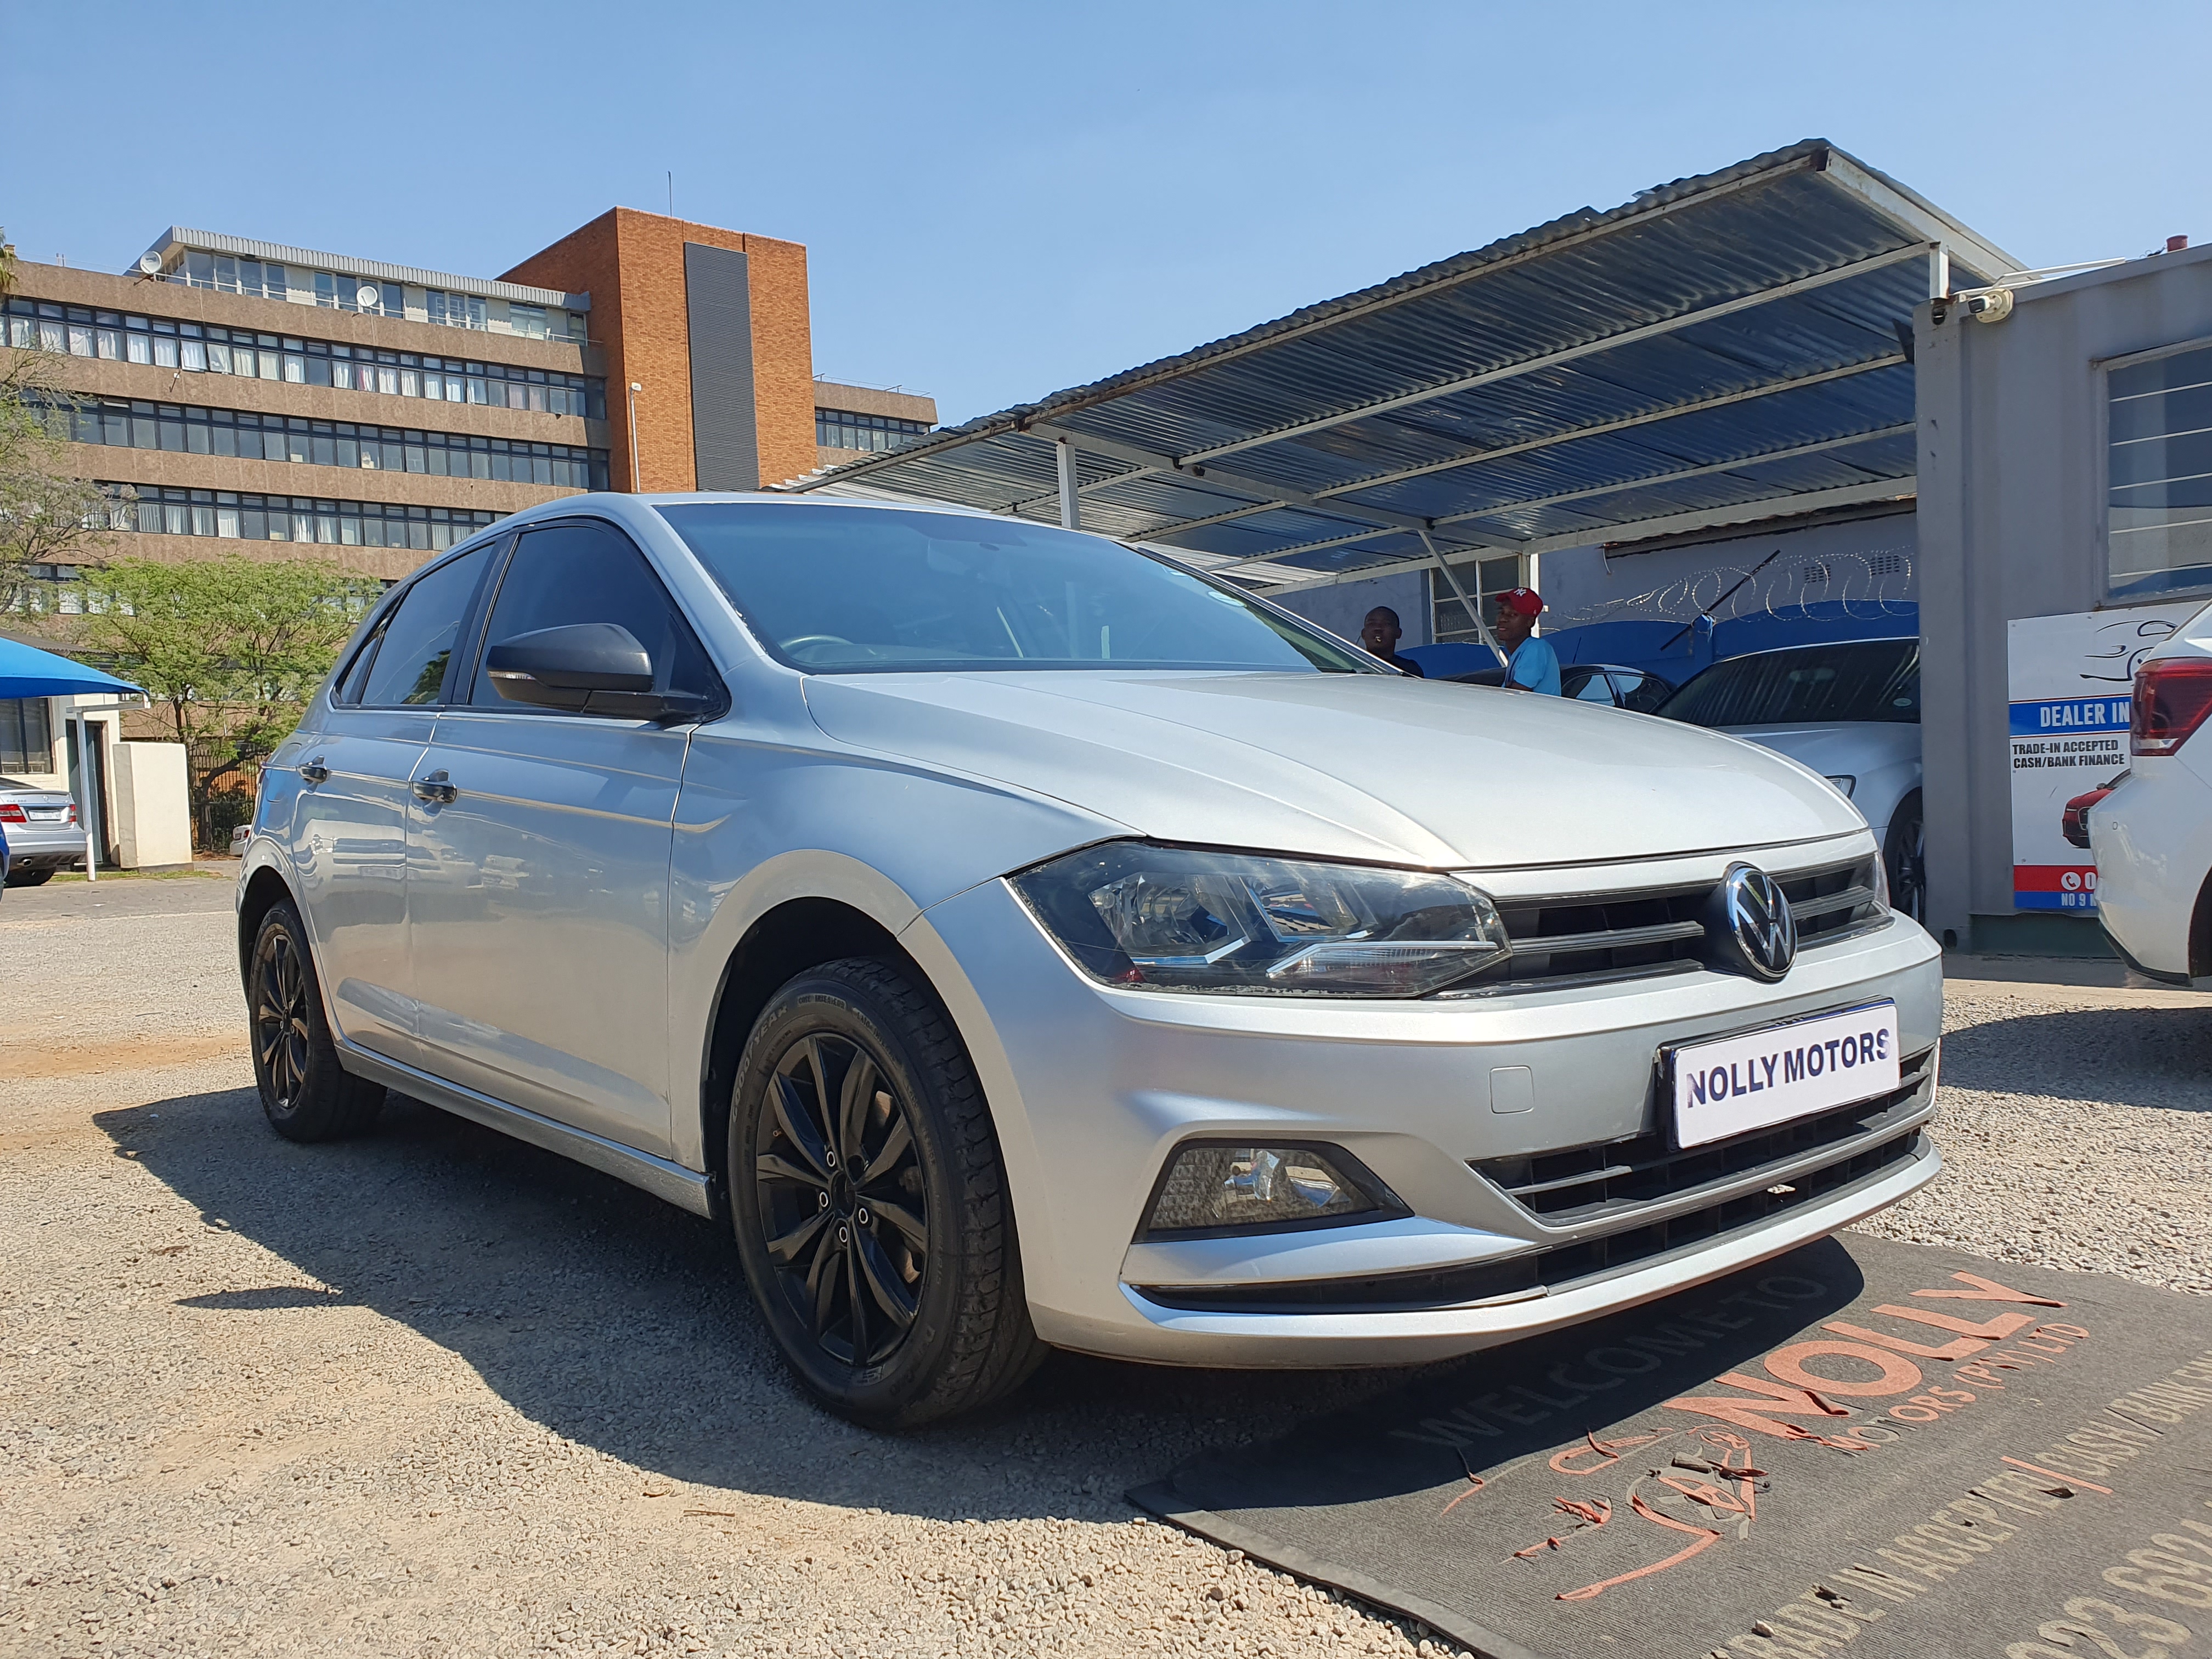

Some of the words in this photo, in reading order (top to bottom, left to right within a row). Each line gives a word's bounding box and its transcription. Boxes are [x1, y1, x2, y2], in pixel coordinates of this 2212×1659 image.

[2012, 742, 2061, 755] TRADE-IN
[2063, 740, 2118, 752] ACCEPTED
[2040, 703, 2106, 727] DEALER
[2112, 702, 2130, 724] IN
[2013, 755, 2076, 769] CASH/BANK
[2079, 754, 2125, 766] FINANCE
[2061, 893, 2075, 906] NO
[2079, 893, 2086, 906] 9
[732, 1005, 787, 1123] GOODYEAR
[1686, 1053, 1779, 1108] NOLLY
[1784, 1029, 1891, 1084] MOTORS
[1389, 1310, 1753, 1448] WELCOME
[1719, 1276, 1827, 1310] TO
[1661, 1269, 2068, 1440] NOLLY
[1822, 1386, 1976, 1457] MOTORS
[2018, 1323, 2090, 1353] LTD
[1875, 1468, 2076, 1582] ACCEPTED
[1700, 1581, 1888, 1659] RADE
[1828, 1562, 1928, 1602] IN
